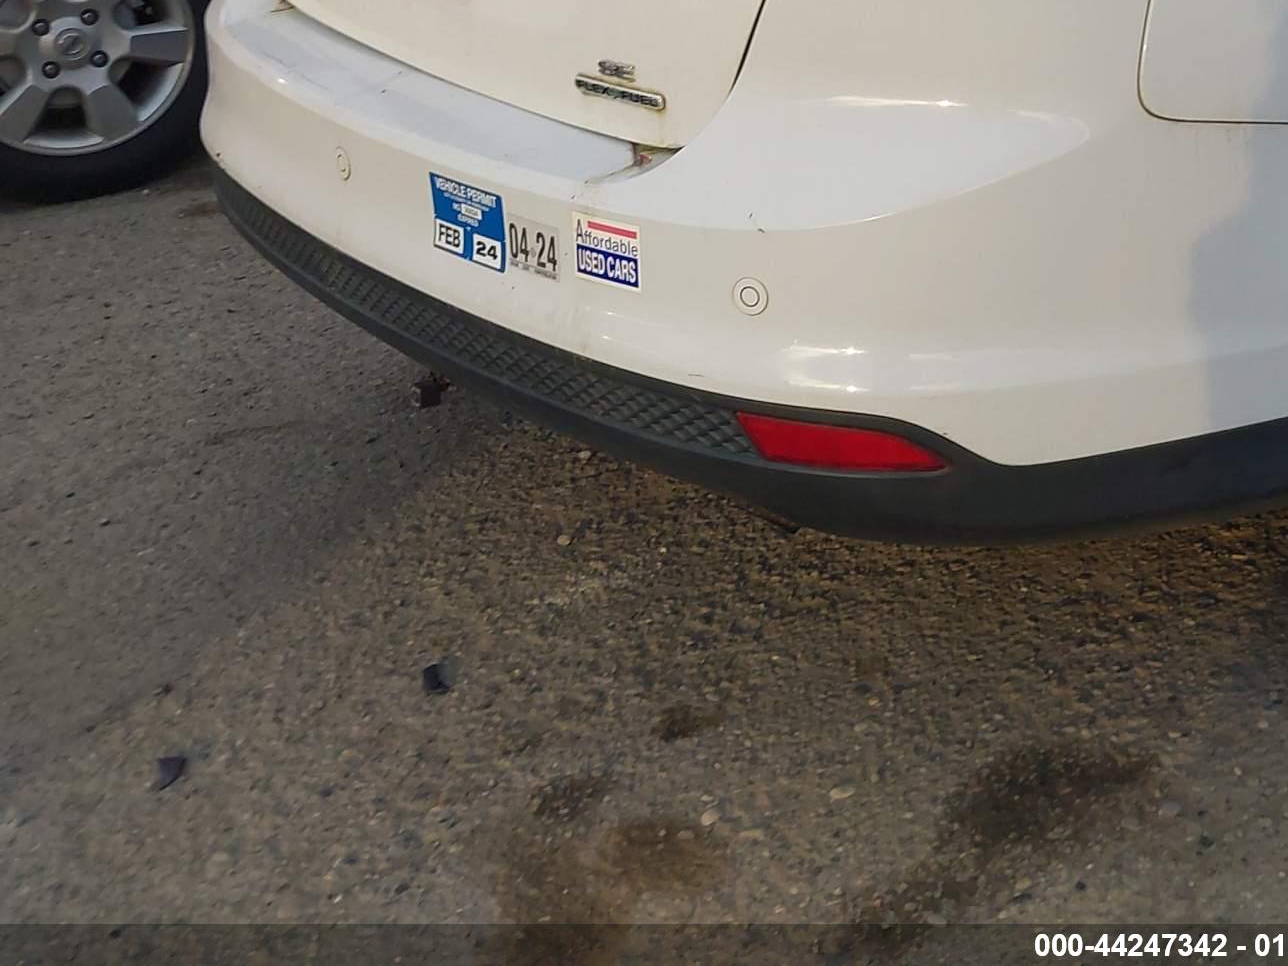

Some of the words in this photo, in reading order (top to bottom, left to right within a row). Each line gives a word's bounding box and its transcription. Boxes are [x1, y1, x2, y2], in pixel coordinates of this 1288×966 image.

[598, 59, 636, 82] SE
[438, 223, 461, 248] FEB
[476, 240, 498, 260] 24
[576, 218, 638, 257] Affordable
[578, 248, 606, 275] USED
[606, 256, 637, 284] CARS
